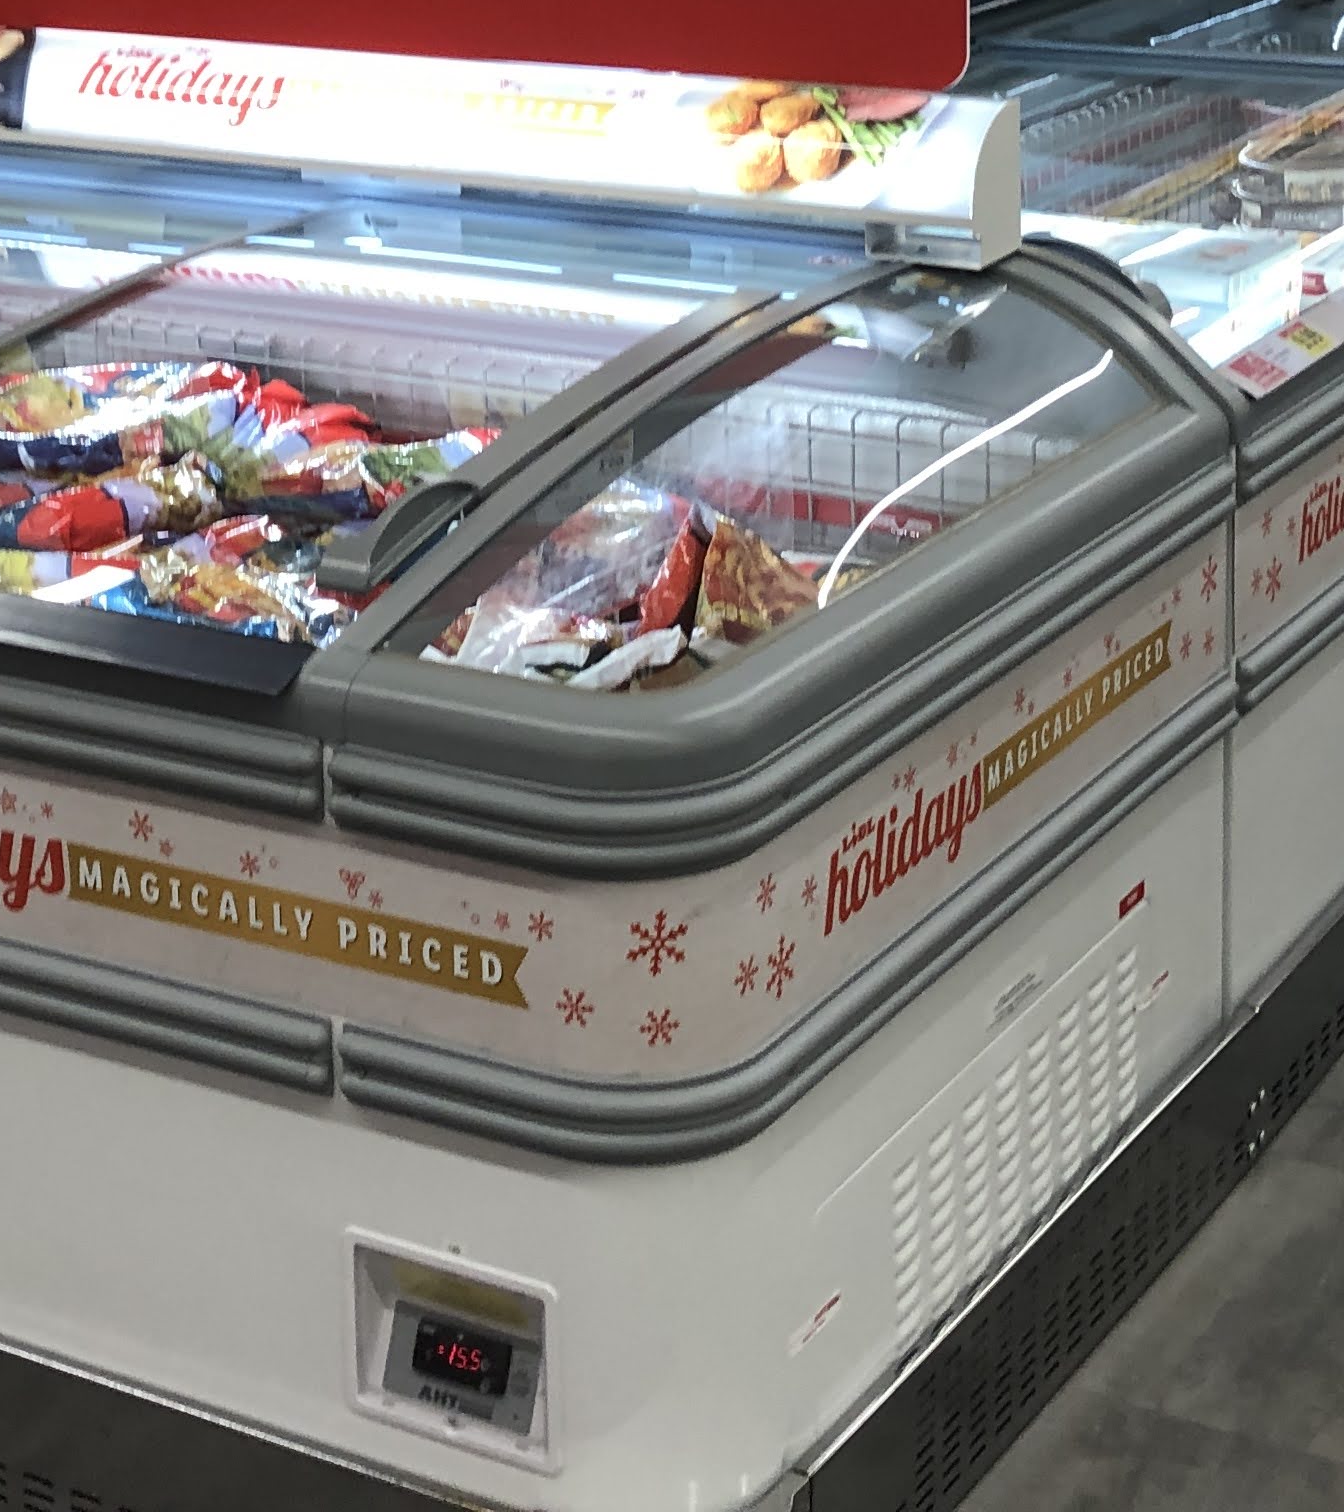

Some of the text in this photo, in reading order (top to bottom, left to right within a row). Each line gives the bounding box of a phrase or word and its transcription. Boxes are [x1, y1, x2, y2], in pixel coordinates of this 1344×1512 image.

[78, 49, 286, 127] holidays
[823, 641, 1167, 936] holidays MAGICALLY PRICED
[77, 854, 315, 941] MAGICALLY
[337, 914, 506, 986] PRICED
